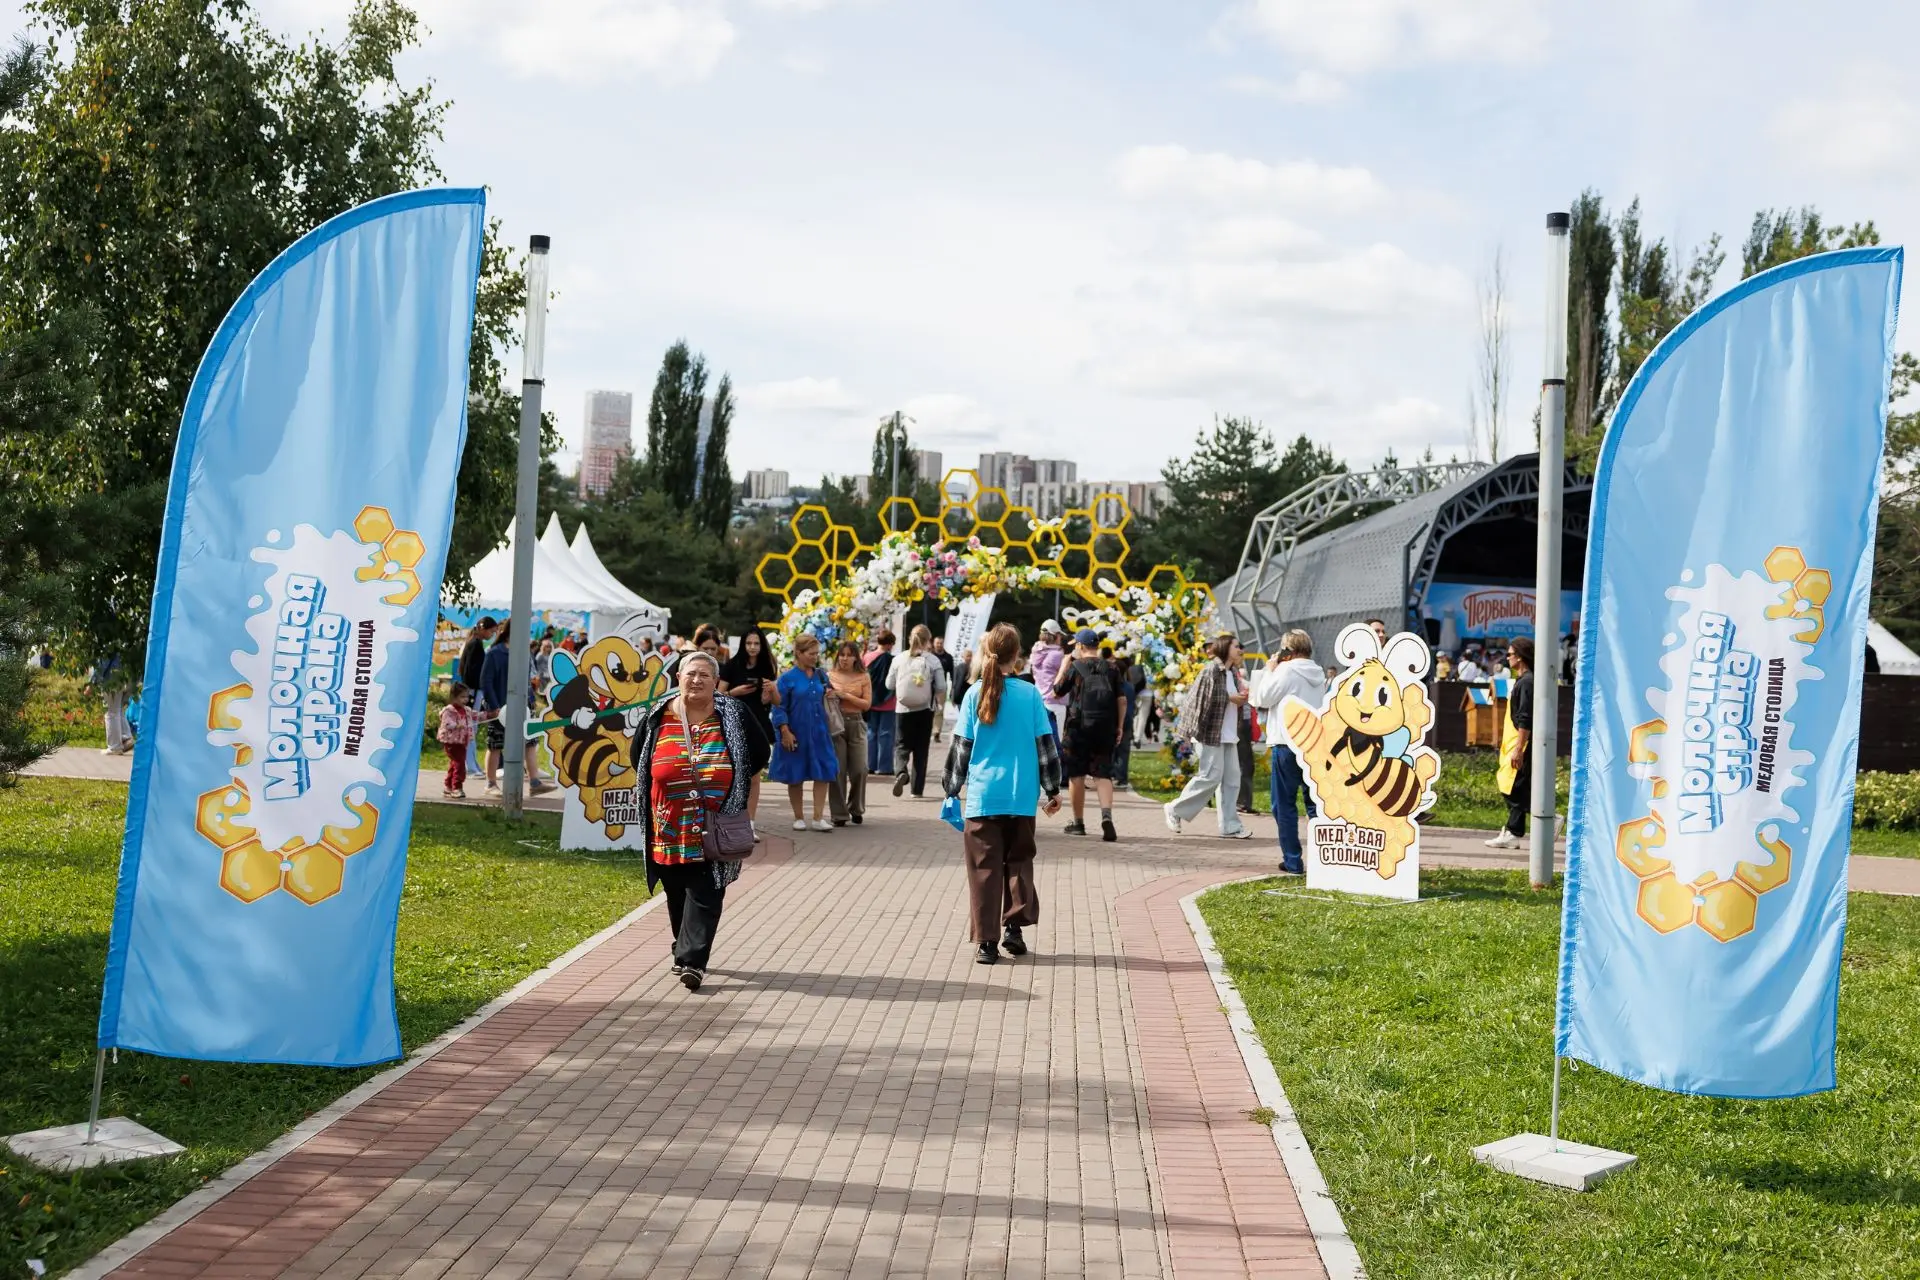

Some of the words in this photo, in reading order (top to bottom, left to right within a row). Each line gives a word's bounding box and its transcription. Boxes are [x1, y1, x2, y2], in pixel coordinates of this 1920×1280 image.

[263, 573, 327, 801] Молочная
[354, 619, 375, 686] СТОЛИЦА
[344, 685, 370, 757] МЕДОВАЯ
[1679, 611, 1736, 834] Молочная
[1765, 657, 1785, 723] СТОЛИЦА
[1756, 721, 1780, 794] МЕДОВАЯ
[607, 808, 637, 823] СТОЛ
[1322, 848, 1377, 867] СТОЛИЦА
